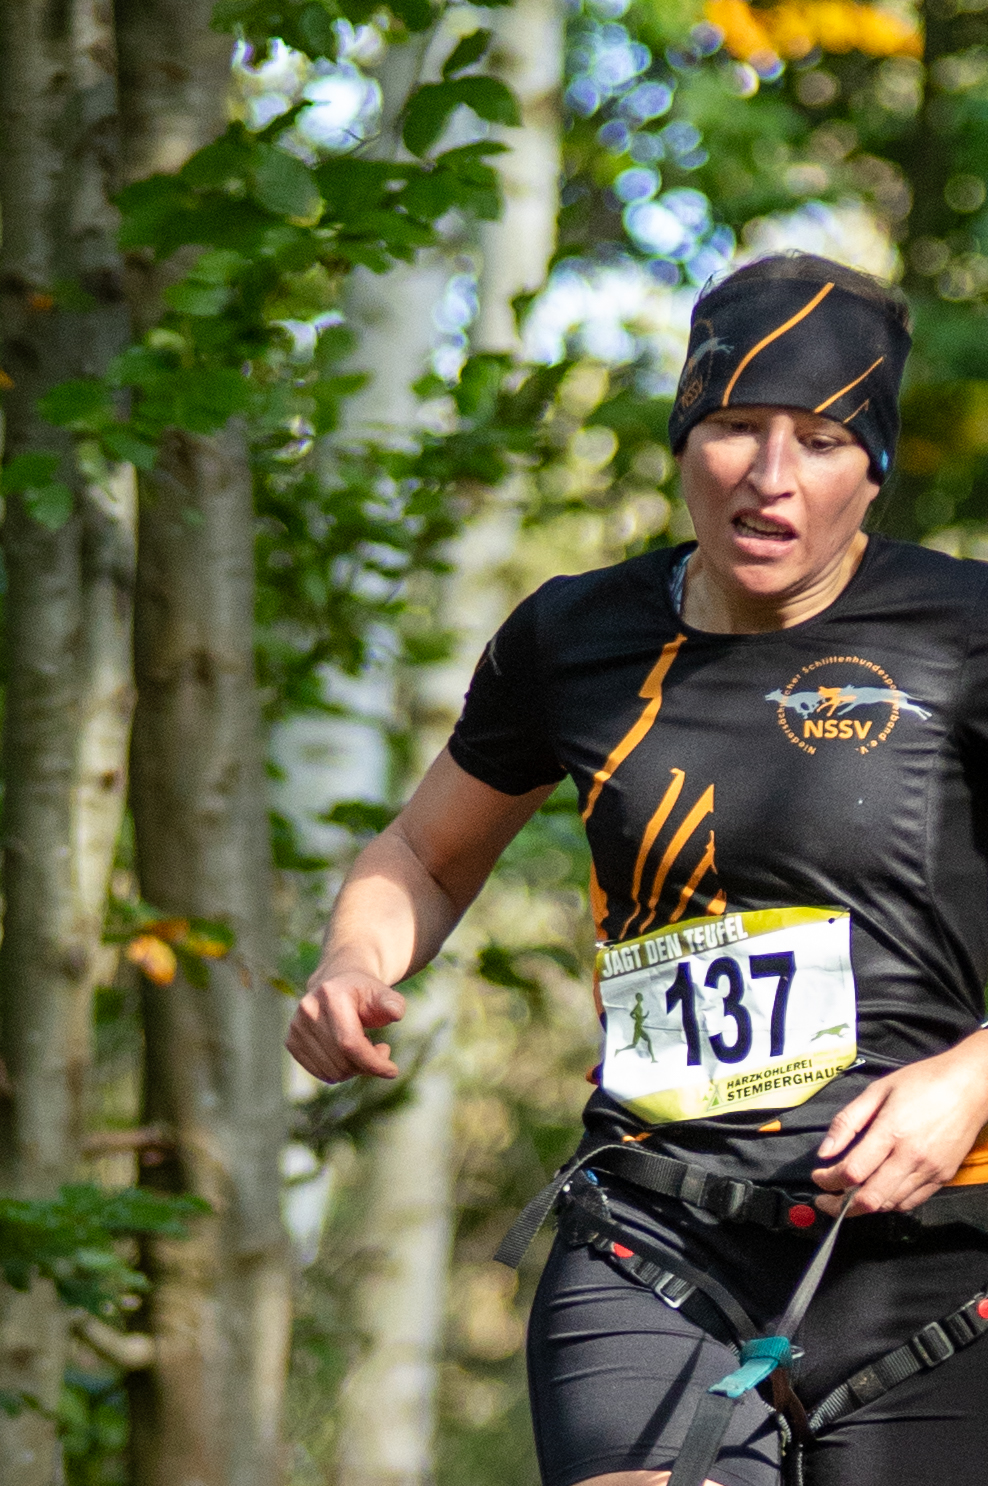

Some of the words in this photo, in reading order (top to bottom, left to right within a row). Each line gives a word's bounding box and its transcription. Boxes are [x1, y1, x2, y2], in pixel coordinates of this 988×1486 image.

[803, 719, 873, 739] NSSV
[602, 947, 643, 978] JAGT
[645, 932, 684, 964] DEN
[683, 915, 749, 954] TEUFEL
[665, 951, 797, 1066] 137
